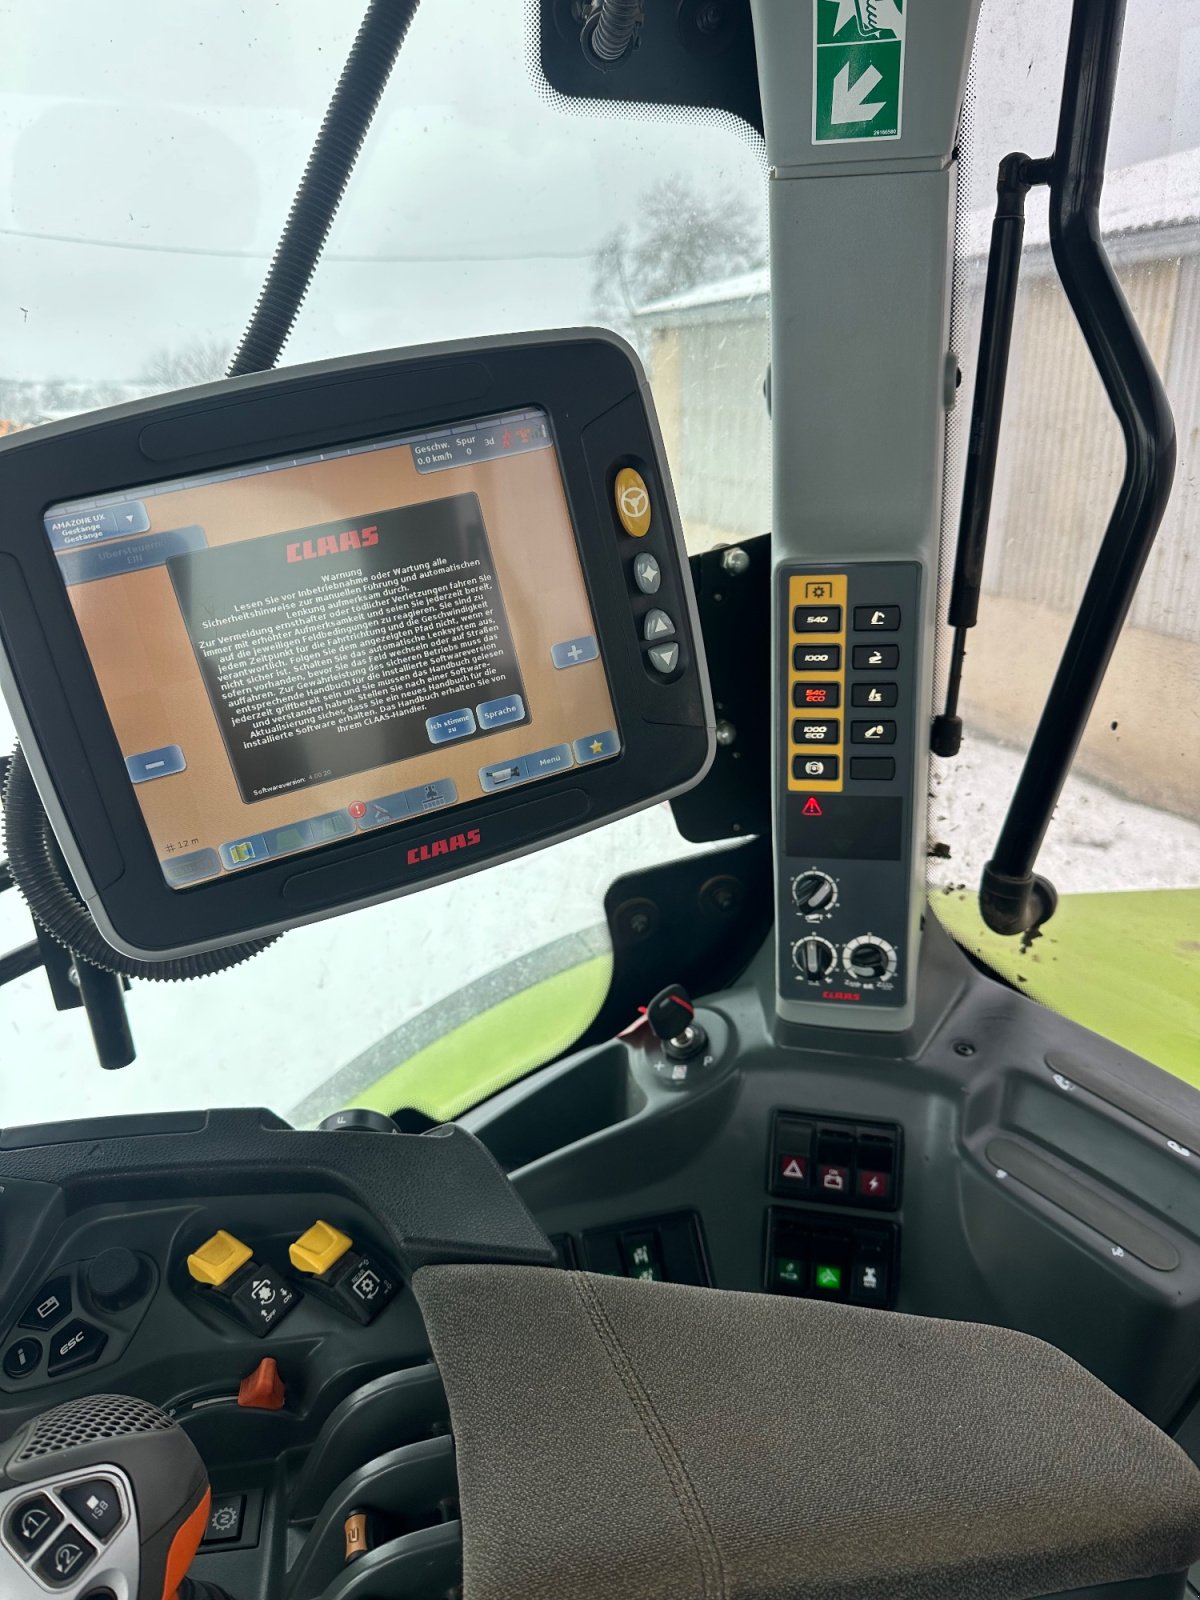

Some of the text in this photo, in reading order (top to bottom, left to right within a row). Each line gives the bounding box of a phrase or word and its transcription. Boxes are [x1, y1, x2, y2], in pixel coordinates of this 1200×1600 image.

[415, 435, 476, 455] Geschw. Spur
[417, 454, 431, 465] 0.0
[432, 451, 453, 463] km/h
[484, 437, 495, 446] 3d
[50, 513, 106, 530] AMAZONE UX
[286, 526, 379, 564] CLAAS
[201, 600, 296, 629] Sicherheitshinweise
[297, 597, 313, 606] zur
[314, 585, 361, 602] manuellen
[399, 572, 417, 582] und
[418, 557, 480, 578] automatischen
[233, 556, 447, 612] Lesen Sie vor Inbetriebnahme oder Wartung alle
[320, 566, 363, 584] Warnung
[197, 638, 216, 649] Zur
[216, 624, 274, 646] Vermeidung
[273, 611, 327, 631] ernsthafter
[328, 606, 350, 618] oder
[390, 583, 448, 605] Verletzungen
[448, 576, 477, 589] fahren
[478, 572, 491, 582] Sie
[285, 583, 409, 621] Lenkung aufmerksam durch.
[806, 615, 829, 624] 540
[202, 643, 233, 657] immer
[233, 639, 249, 650] mit
[292, 612, 365, 635] Aufmerksamkeit
[365, 607, 384, 618] und
[384, 601, 409, 613] seien
[409, 597, 424, 607] Sie
[425, 588, 463, 606] jederzeit
[217, 659, 248, 674] jedem
[248, 647, 295, 667] Zeitpunkt
[310, 639, 326, 650] die
[326, 625, 386, 648] Fahrtrichtung
[386, 620, 404, 631] und
[405, 616, 419, 626] die
[420, 600, 488, 625] Geschwindigkeit
[218, 593, 483, 663] auf die jeweiligen Feldbedingungen zu reagieren. Sie sind zu
[216, 658, 288, 682] verantwortlich.
[289, 650, 321, 666] Folgen
[321, 646, 337, 656] Sie
[337, 641, 357, 652] dem
[358, 627, 414, 649] angezeigten
[413, 622, 434, 633] Pfad
[460, 611, 483, 622] wenn
[484, 608, 494, 616] er
[219, 678, 244, 691] nicht
[245, 670, 274, 684] sicher
[275, 666, 291, 677] ist.
[292, 656, 332, 672] Schalten
[333, 652, 348, 662] Sie
[349, 648, 366, 658] das
[367, 633, 425, 654] automatische
[426, 620, 477, 641] Lenksystem
[220, 685, 252, 700] sofern
[306, 665, 333, 678] bevor
[333, 661, 349, 671] Sie
[349, 656, 367, 667] das
[367, 651, 387, 662] Feld
[388, 641, 428, 657] wechseln
[429, 635, 450, 647] oder
[450, 632, 465, 642] auf
[465, 623, 499, 638] Straßen
[804, 654, 829, 662] 1000
[234, 690, 305, 717] entsprechende
[305, 678, 351, 696] Handbuch
[365, 671, 380, 681] die
[381, 658, 428, 677] installierte
[429, 641, 496, 664] Softwareversion
[251, 660, 490, 729] und verstanden haben. Stellen Sie nach einer Software-
[242, 674, 506, 749] installierte Software erhalten. Das Handbuch erhalten Sie von
[248, 714, 316, 740] Aktualisierung
[346, 700, 368, 712] dass
[369, 696, 384, 706] Sie
[384, 692, 399, 702] ein
[400, 686, 427, 698] neues
[427, 674, 469, 691] Handbuch
[483, 666, 497, 676] die
[442, 713, 470, 726] stimme
[483, 704, 517, 721] Sprache
[336, 720, 362, 733] Ihrem
[539, 753, 561, 766] Menü
[177, 838, 189, 848] 12
[407, 828, 481, 865] CLAAS
[60, 1331, 85, 1355] ESC
[91, 1500, 109, 1520] ISB
[60, 1549, 75, 1564] 2
